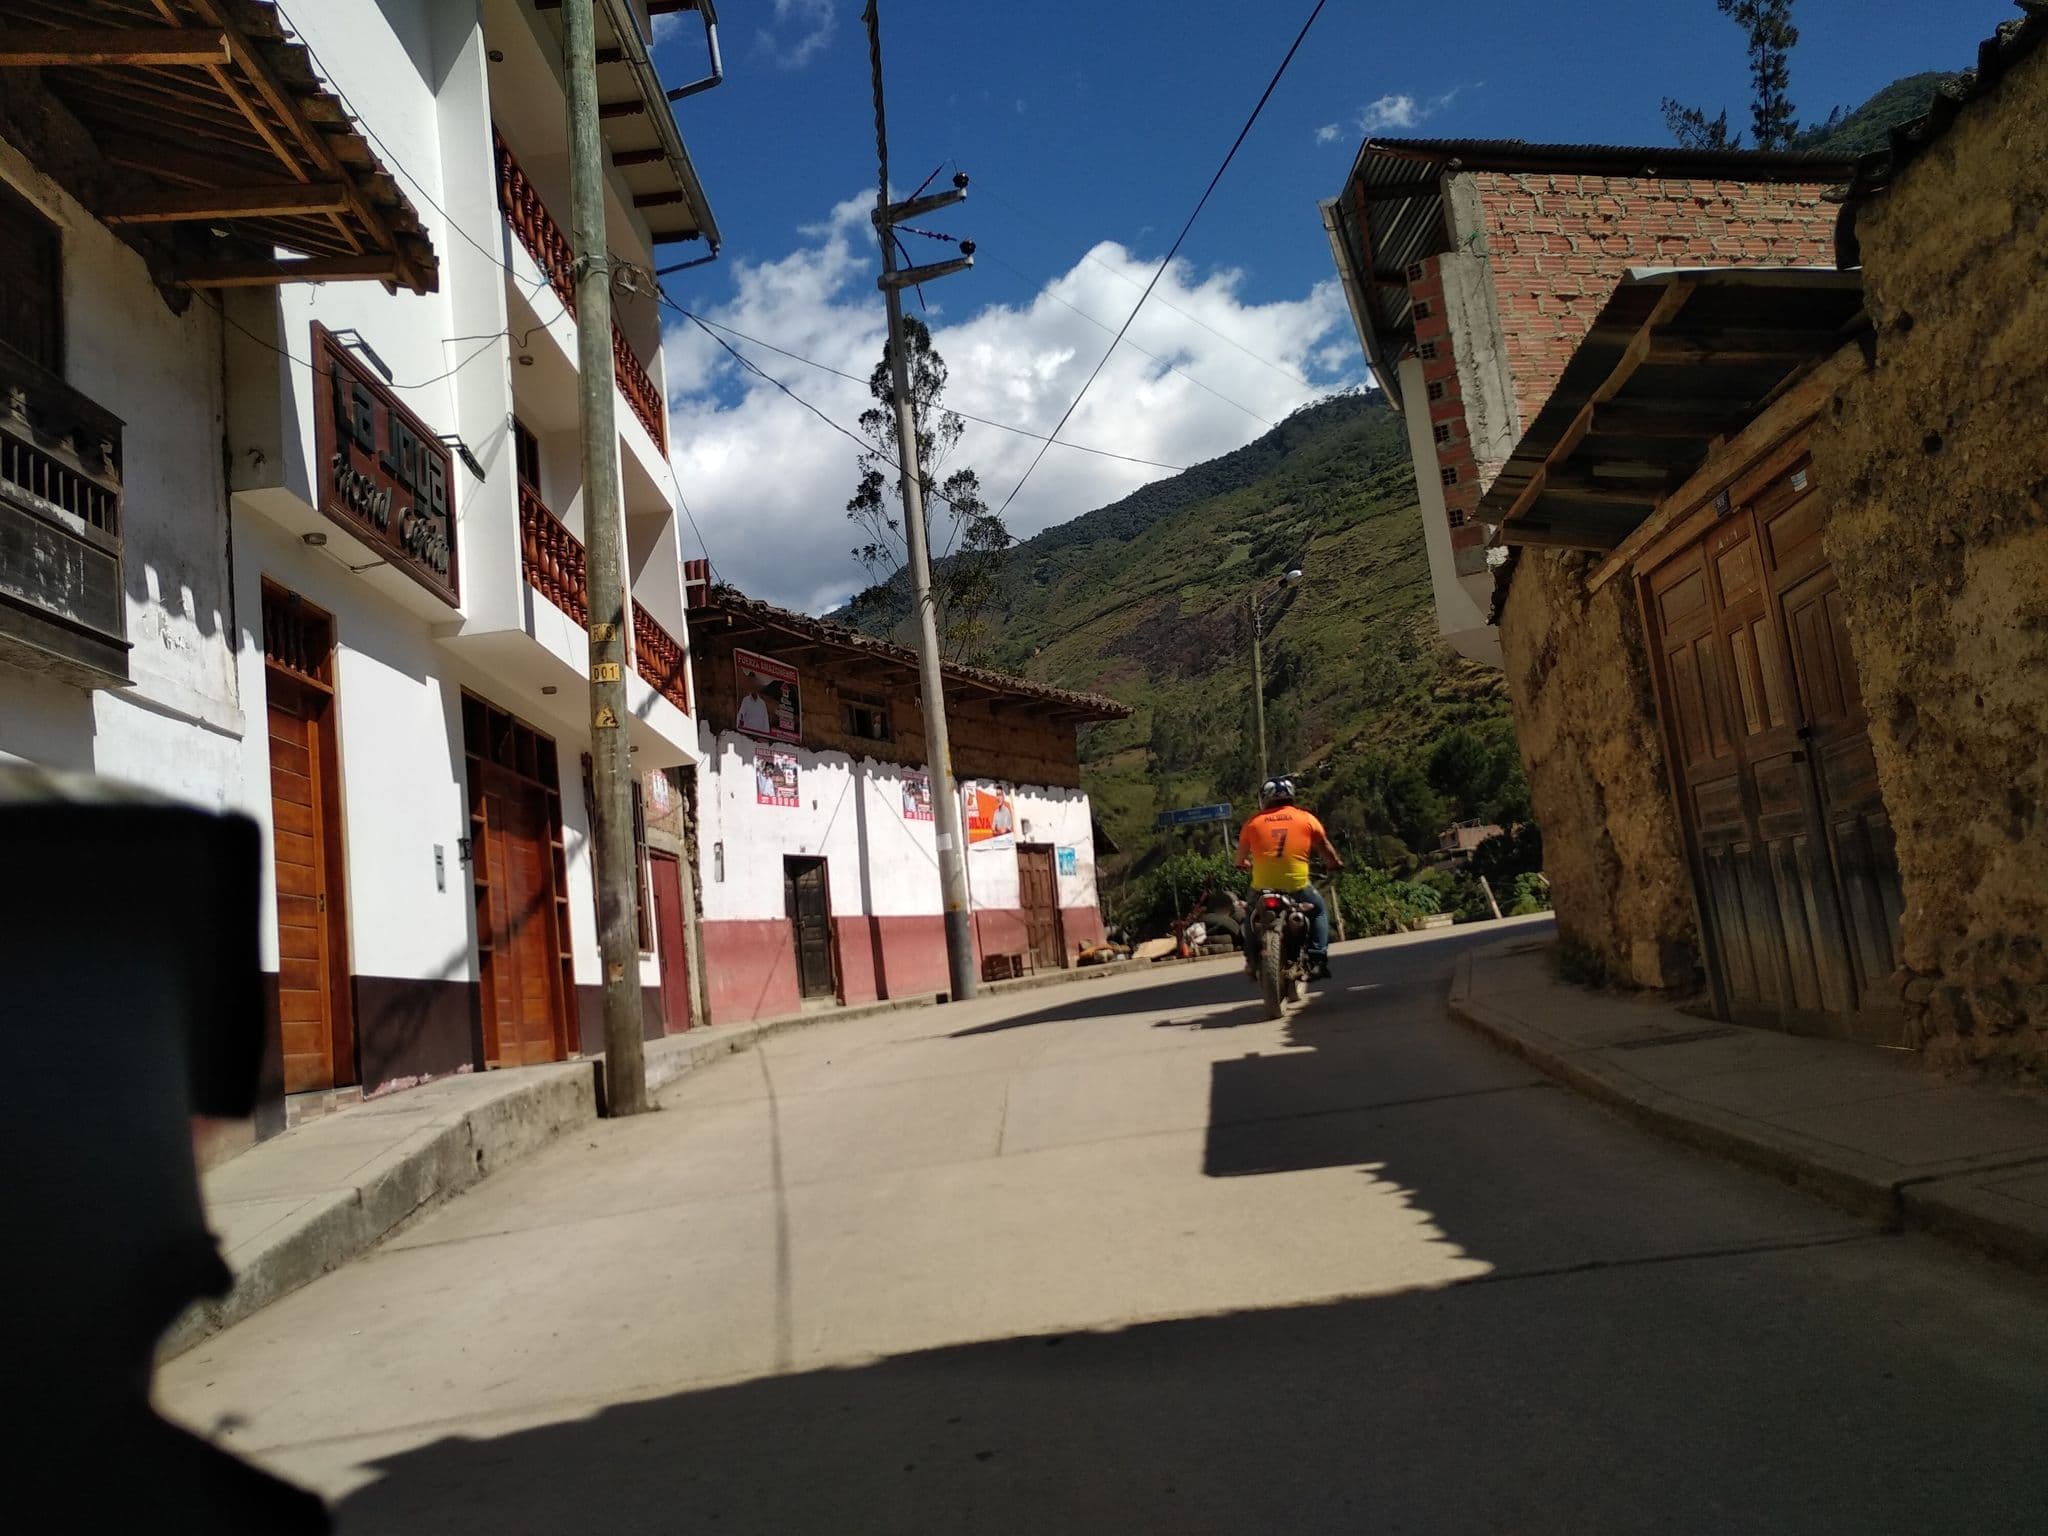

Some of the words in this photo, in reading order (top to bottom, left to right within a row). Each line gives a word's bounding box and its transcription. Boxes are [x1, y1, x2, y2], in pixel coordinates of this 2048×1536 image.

[593, 666, 615, 680] 001
[968, 816, 993, 829] SILVA
[1271, 828, 1289, 857] 7
